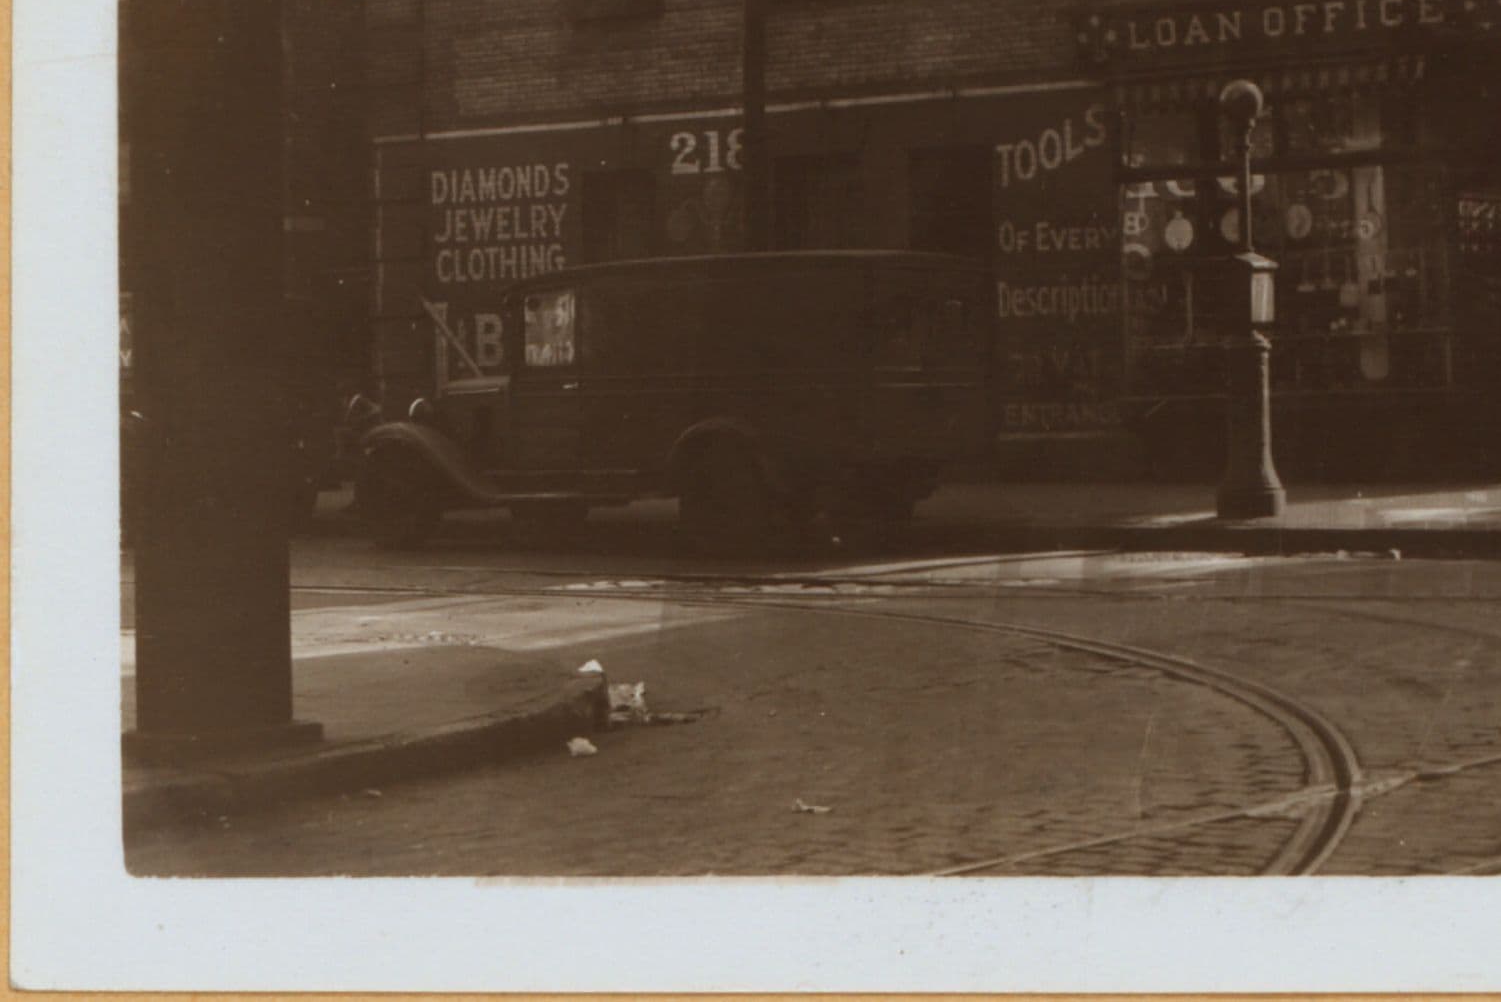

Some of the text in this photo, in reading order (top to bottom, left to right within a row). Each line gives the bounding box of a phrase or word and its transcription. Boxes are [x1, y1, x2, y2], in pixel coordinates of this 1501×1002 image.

[1128, 11, 1244, 50] LOAN
[995, 103, 1106, 188] TOOLS
[431, 163, 570, 205] DIAMONDS
[434, 203, 568, 243] JEWELRY
[434, 243, 567, 284] CLOTHING
